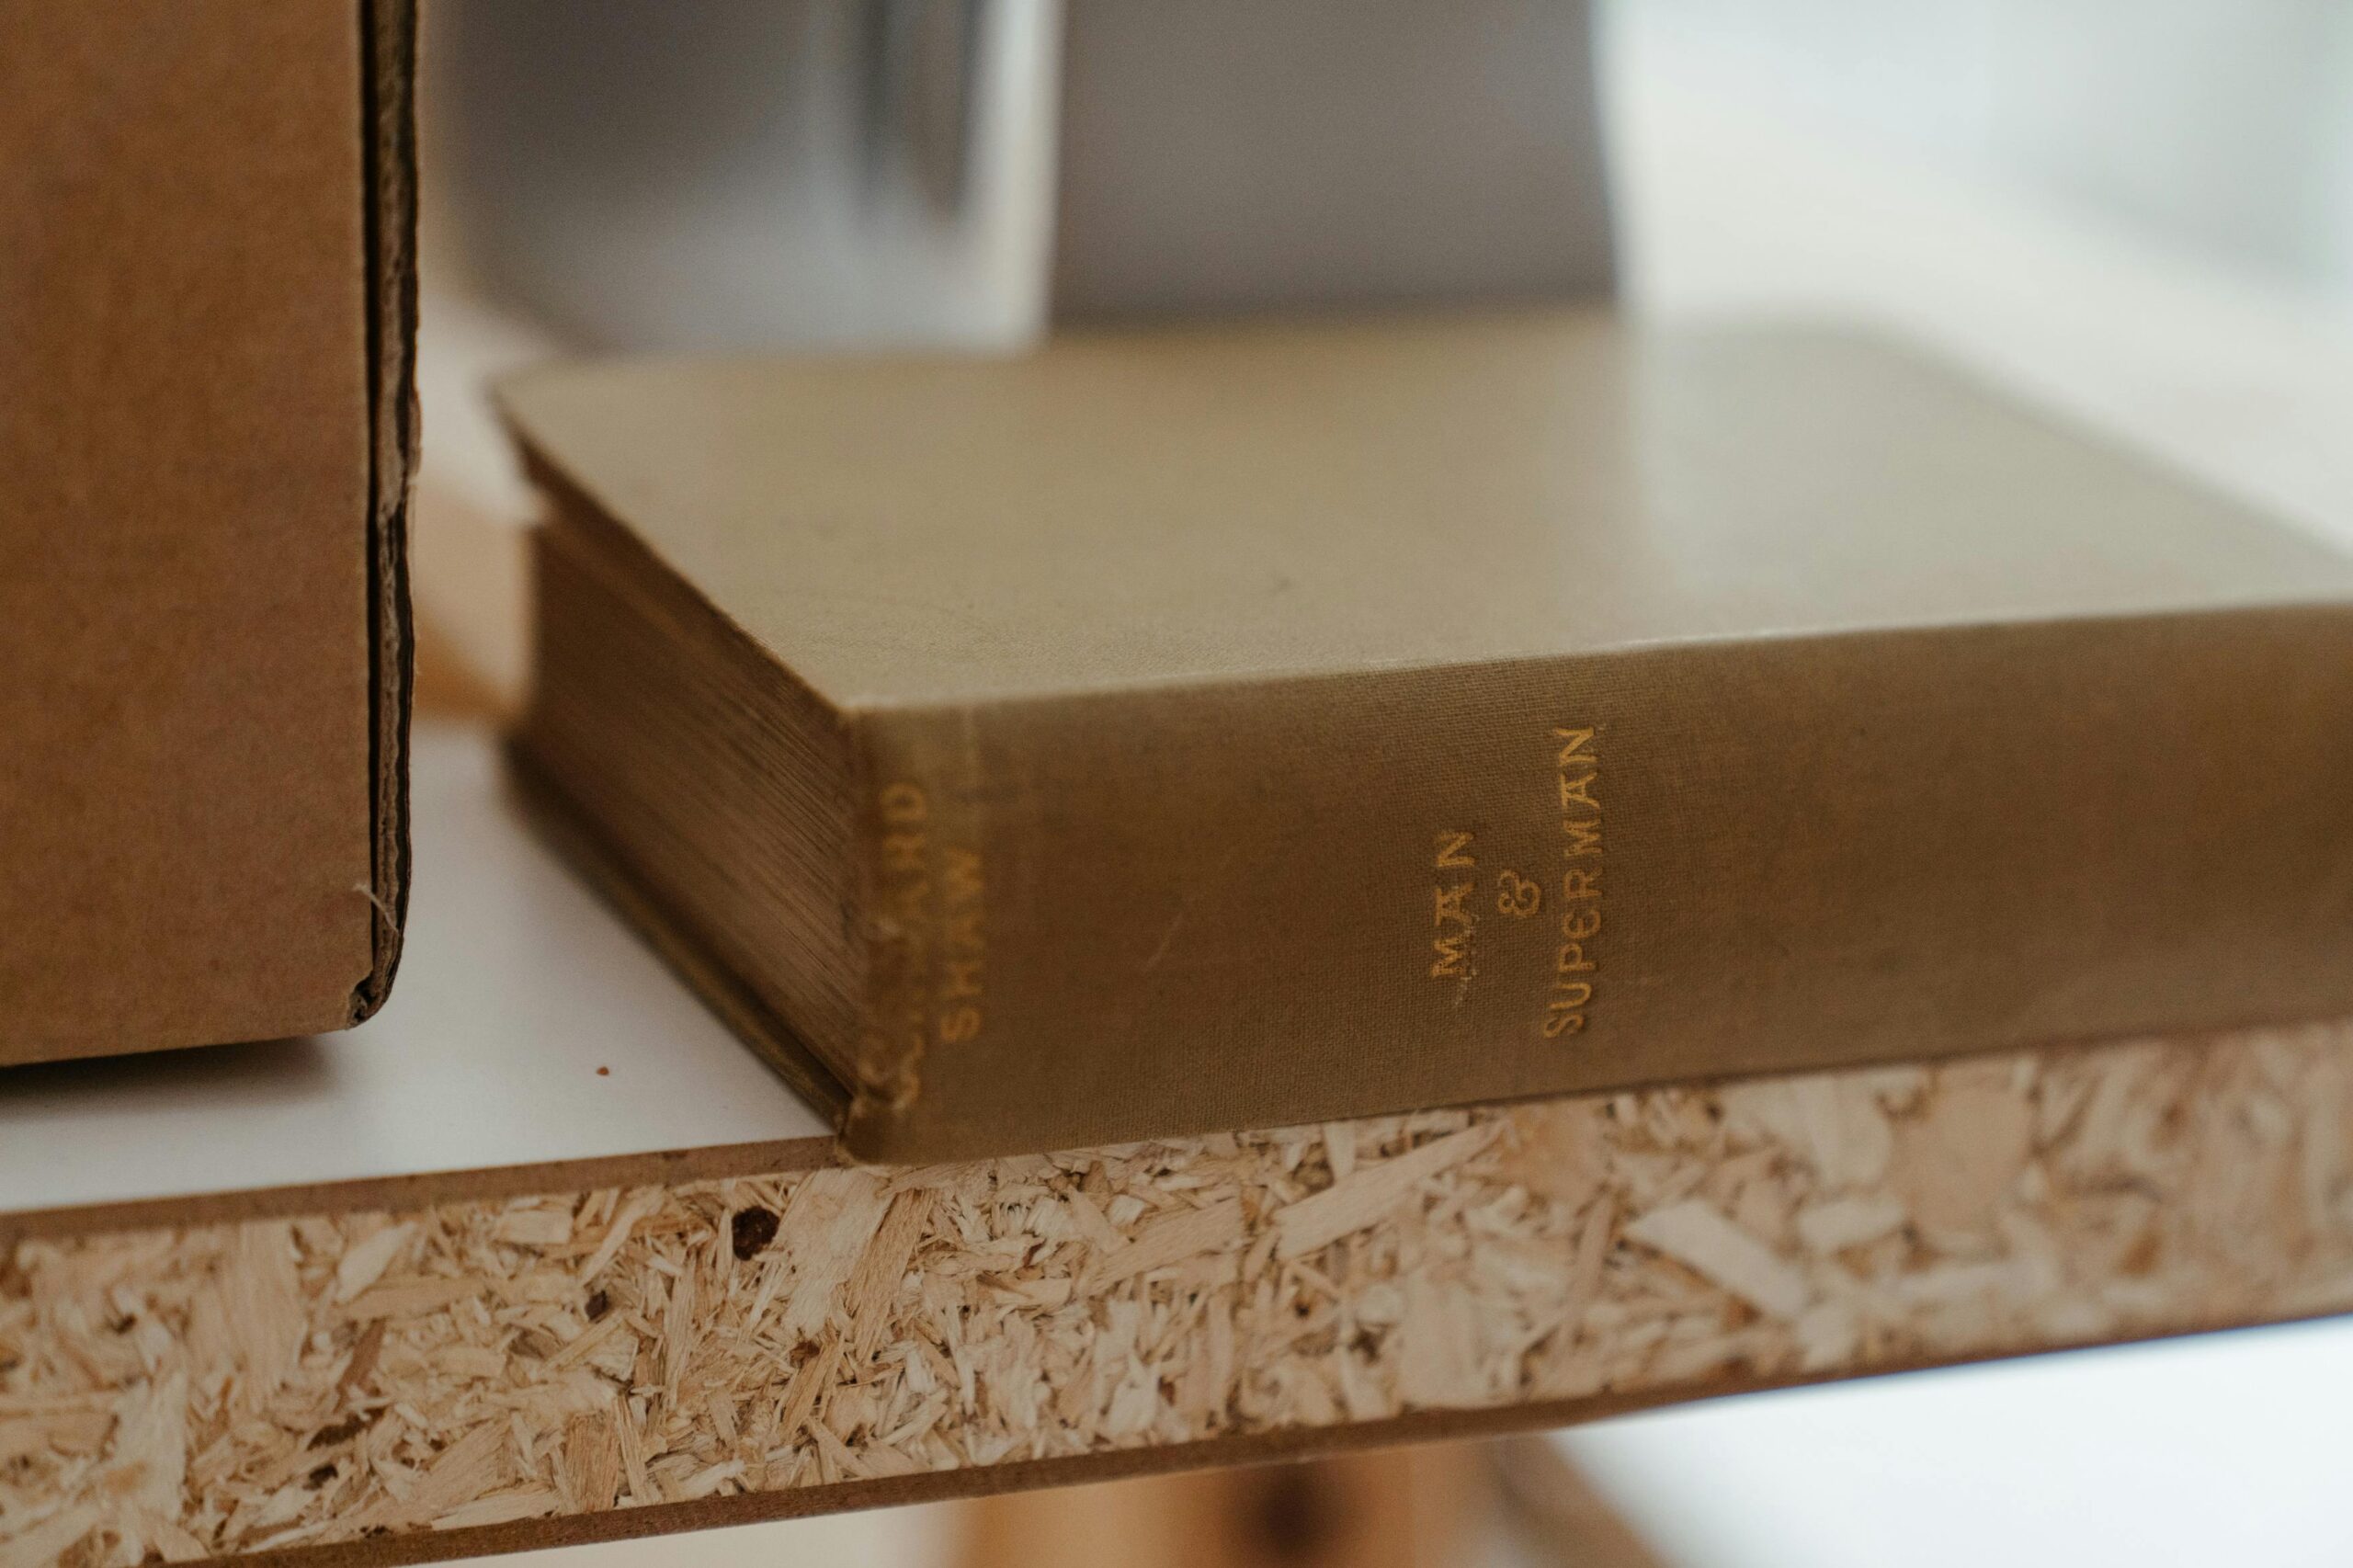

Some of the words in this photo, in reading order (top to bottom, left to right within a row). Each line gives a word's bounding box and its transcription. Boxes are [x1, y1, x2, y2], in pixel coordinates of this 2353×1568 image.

[942, 849, 983, 1042] SHAW
[1432, 830, 1476, 978] MAN
[1498, 869, 1540, 918] &
[1544, 727, 1602, 1039] SUPERMAN
